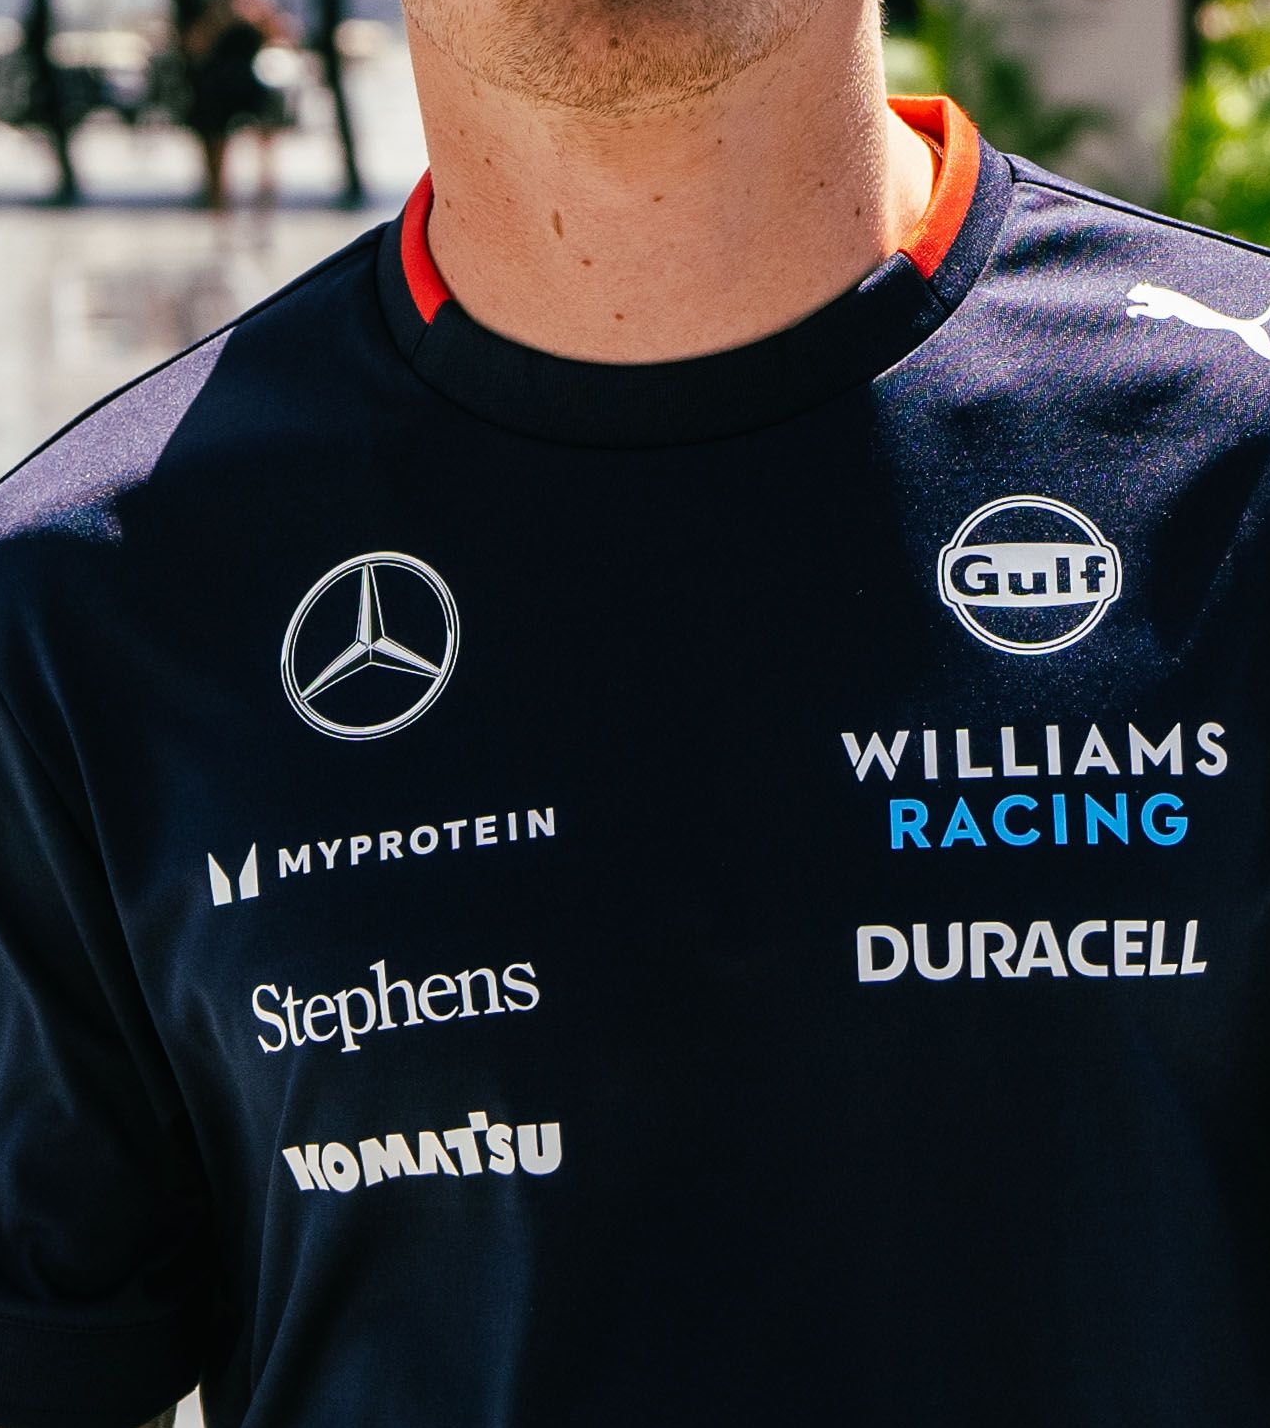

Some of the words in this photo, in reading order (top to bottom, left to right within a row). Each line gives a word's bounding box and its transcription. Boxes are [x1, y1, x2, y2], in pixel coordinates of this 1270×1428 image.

[949, 554, 1107, 598] Gulf
[841, 722, 1228, 782] WILLIAMS
[278, 807, 556, 878] MYPROTEIN
[890, 792, 1188, 850] RACING
[856, 919, 1208, 983] DURACELL
[251, 959, 541, 1054] Stephens
[281, 1111, 563, 1194] KOMATSU
